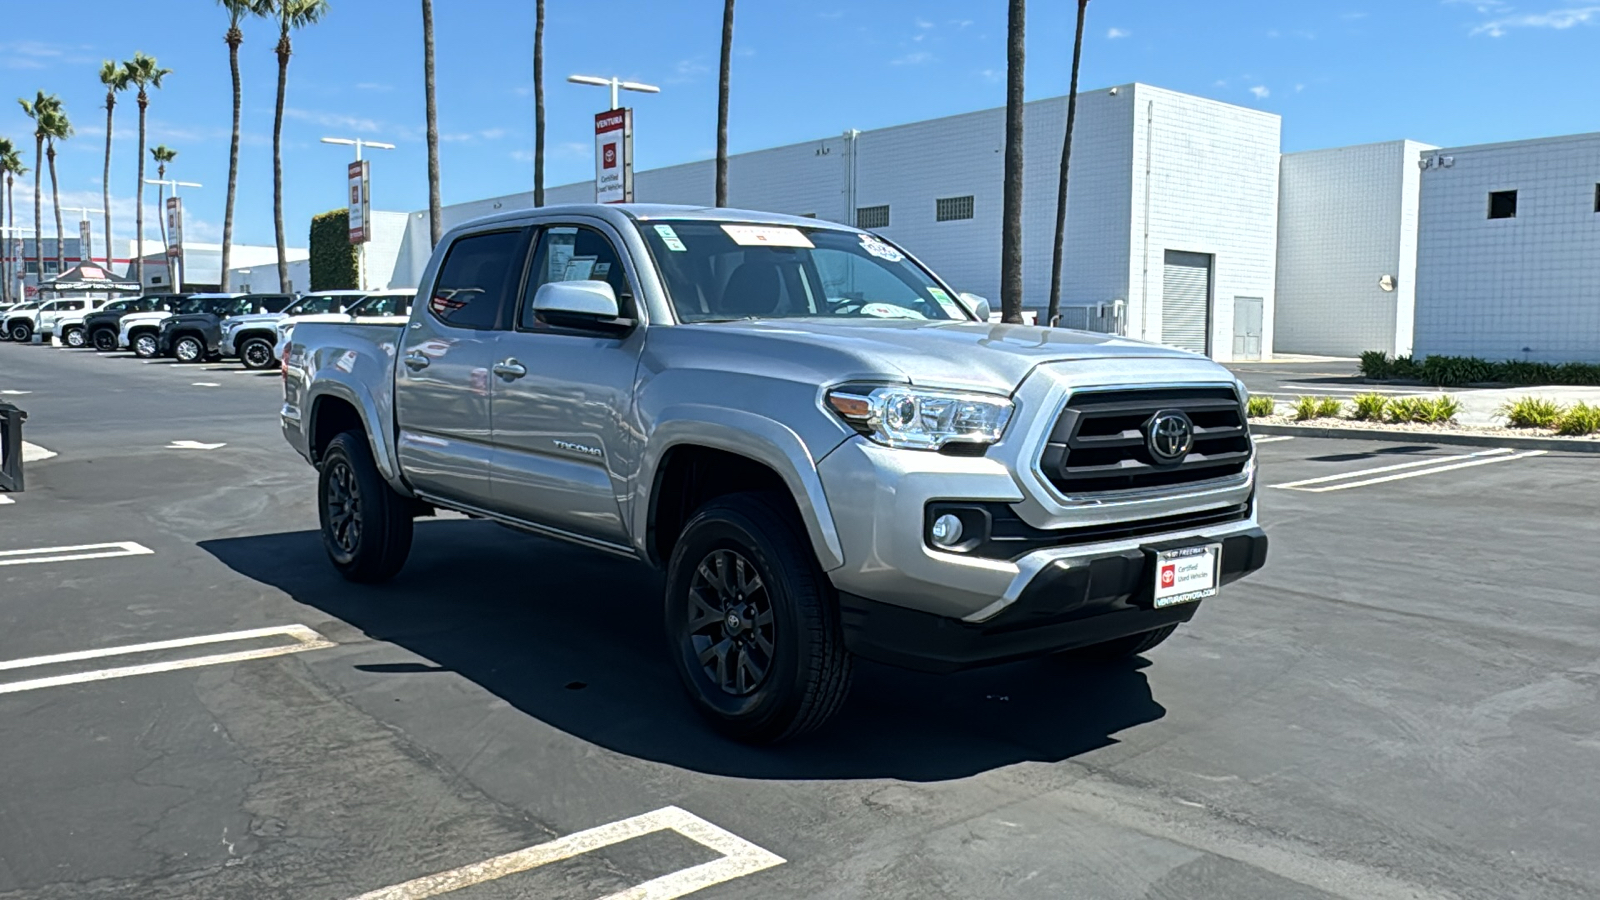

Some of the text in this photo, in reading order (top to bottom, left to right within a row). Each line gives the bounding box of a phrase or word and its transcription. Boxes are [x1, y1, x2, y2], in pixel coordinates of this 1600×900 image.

[596, 115, 623, 129] VENTURA
[601, 174, 618, 183] Certified
[553, 440, 602, 456] TACOMA
[1178, 563, 1198, 573] Certified
[1190, 571, 1208, 580] Vehicles
[1157, 588, 1216, 606] VENTURATOYOTA.COM
